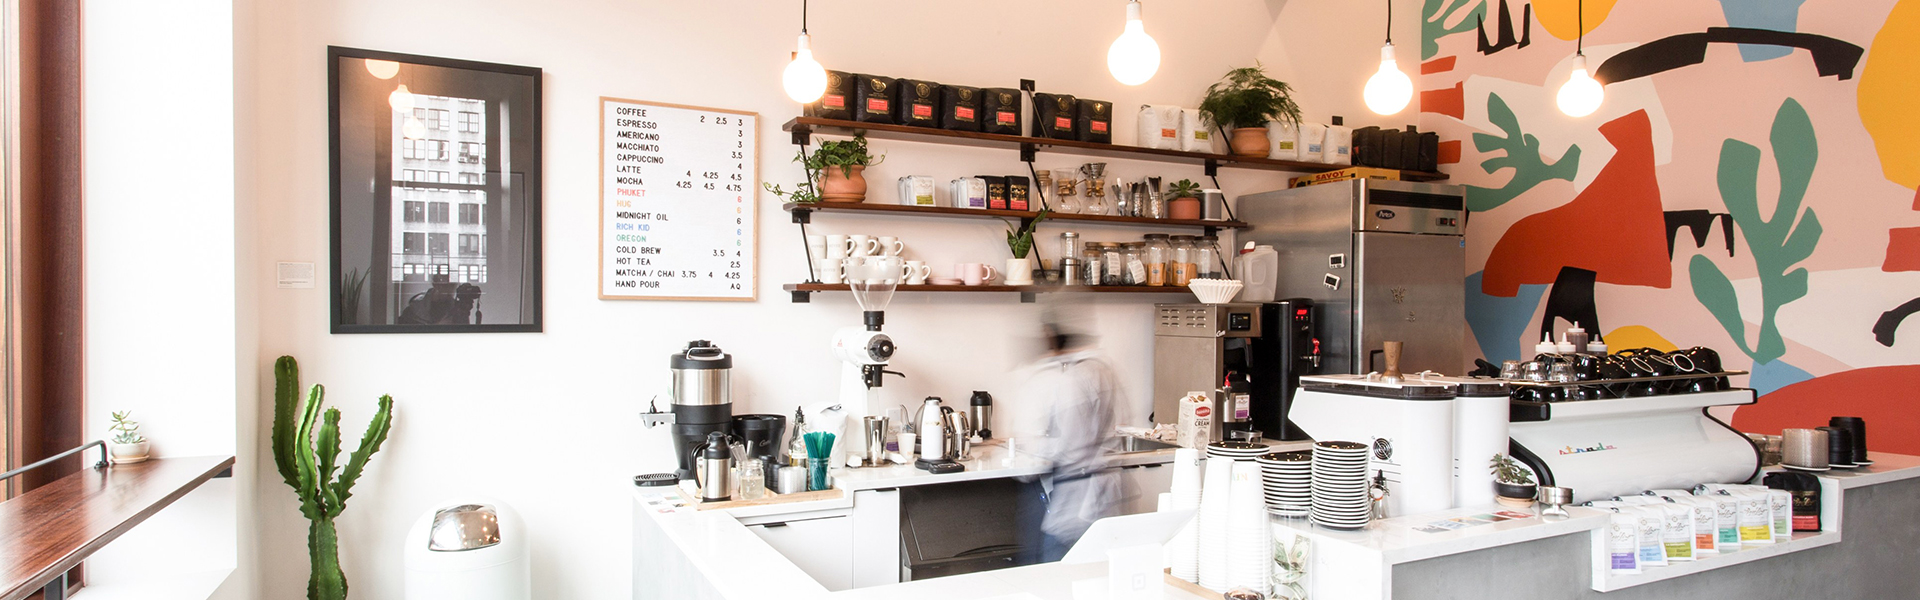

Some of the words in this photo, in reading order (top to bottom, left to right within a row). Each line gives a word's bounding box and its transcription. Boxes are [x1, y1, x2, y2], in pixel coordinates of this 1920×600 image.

[617, 107, 646, 117] COFFEE
[700, 115, 705, 123] 2
[716, 117, 727, 125] 2.5
[617, 119, 657, 129] ESPRESSO
[617, 131, 660, 141] AMERICANO
[617, 142, 660, 152] MACCHIATO
[731, 151, 743, 159] 3.5
[617, 154, 664, 164] CAPPUCCINO
[617, 165, 641, 174] LATTE
[731, 173, 742, 181] 4.5
[1316, 170, 1345, 181] SAVOY
[617, 177, 643, 185] MOCHA
[704, 182, 715, 190] 4.5
[726, 184, 742, 192] 4.75
[617, 188, 646, 197] PHUKET
[617, 212, 651, 220] MIDNIGHT
[656, 213, 668, 221] OIL
[617, 223, 633, 231] RICH
[617, 234, 646, 242] OREGON
[713, 249, 725, 257] 3.5
[616, 280, 636, 288] HAND
[1559, 442, 1617, 455] strada
